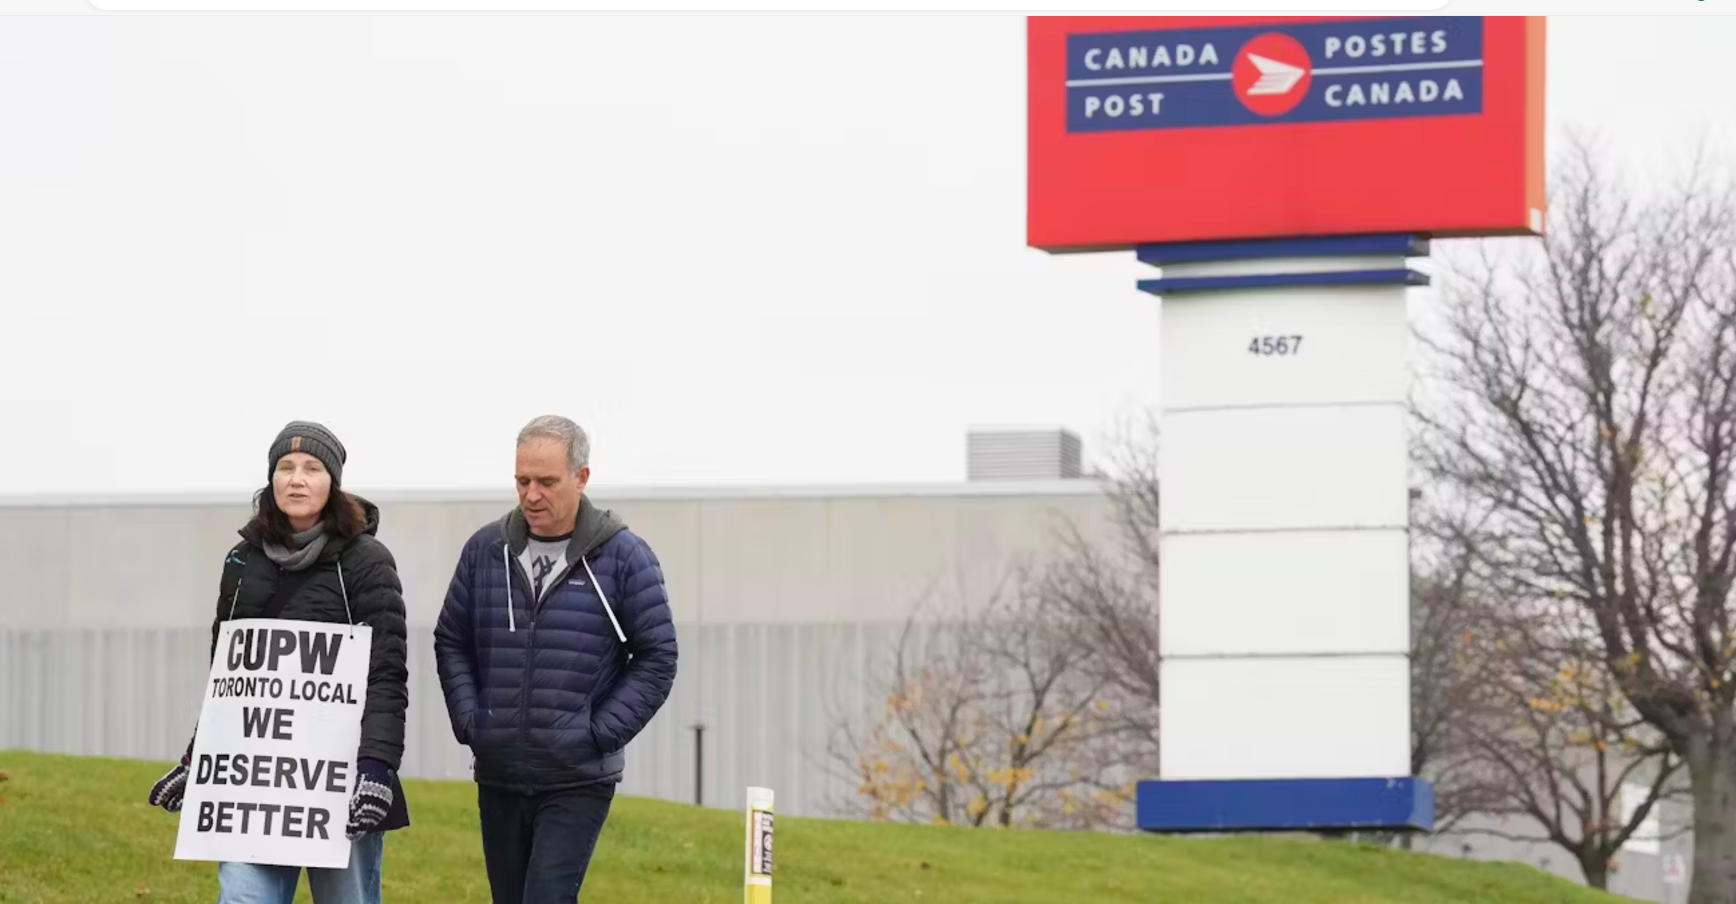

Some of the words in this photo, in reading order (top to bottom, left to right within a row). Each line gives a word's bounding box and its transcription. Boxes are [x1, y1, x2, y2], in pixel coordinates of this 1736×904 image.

[1084, 43, 1219, 71] CANADA
[1325, 30, 1447, 59] POSTES
[1085, 93, 1165, 118] POST
[1325, 78, 1463, 107] CANADA
[1248, 335, 1303, 355] 4567
[227, 628, 343, 675] CUPW
[212, 677, 283, 698] TORONTO
[290, 679, 357, 704] LOCAL
[243, 707, 295, 740] WE
[195, 754, 349, 793] DESERVE
[197, 801, 330, 840] BETTER
